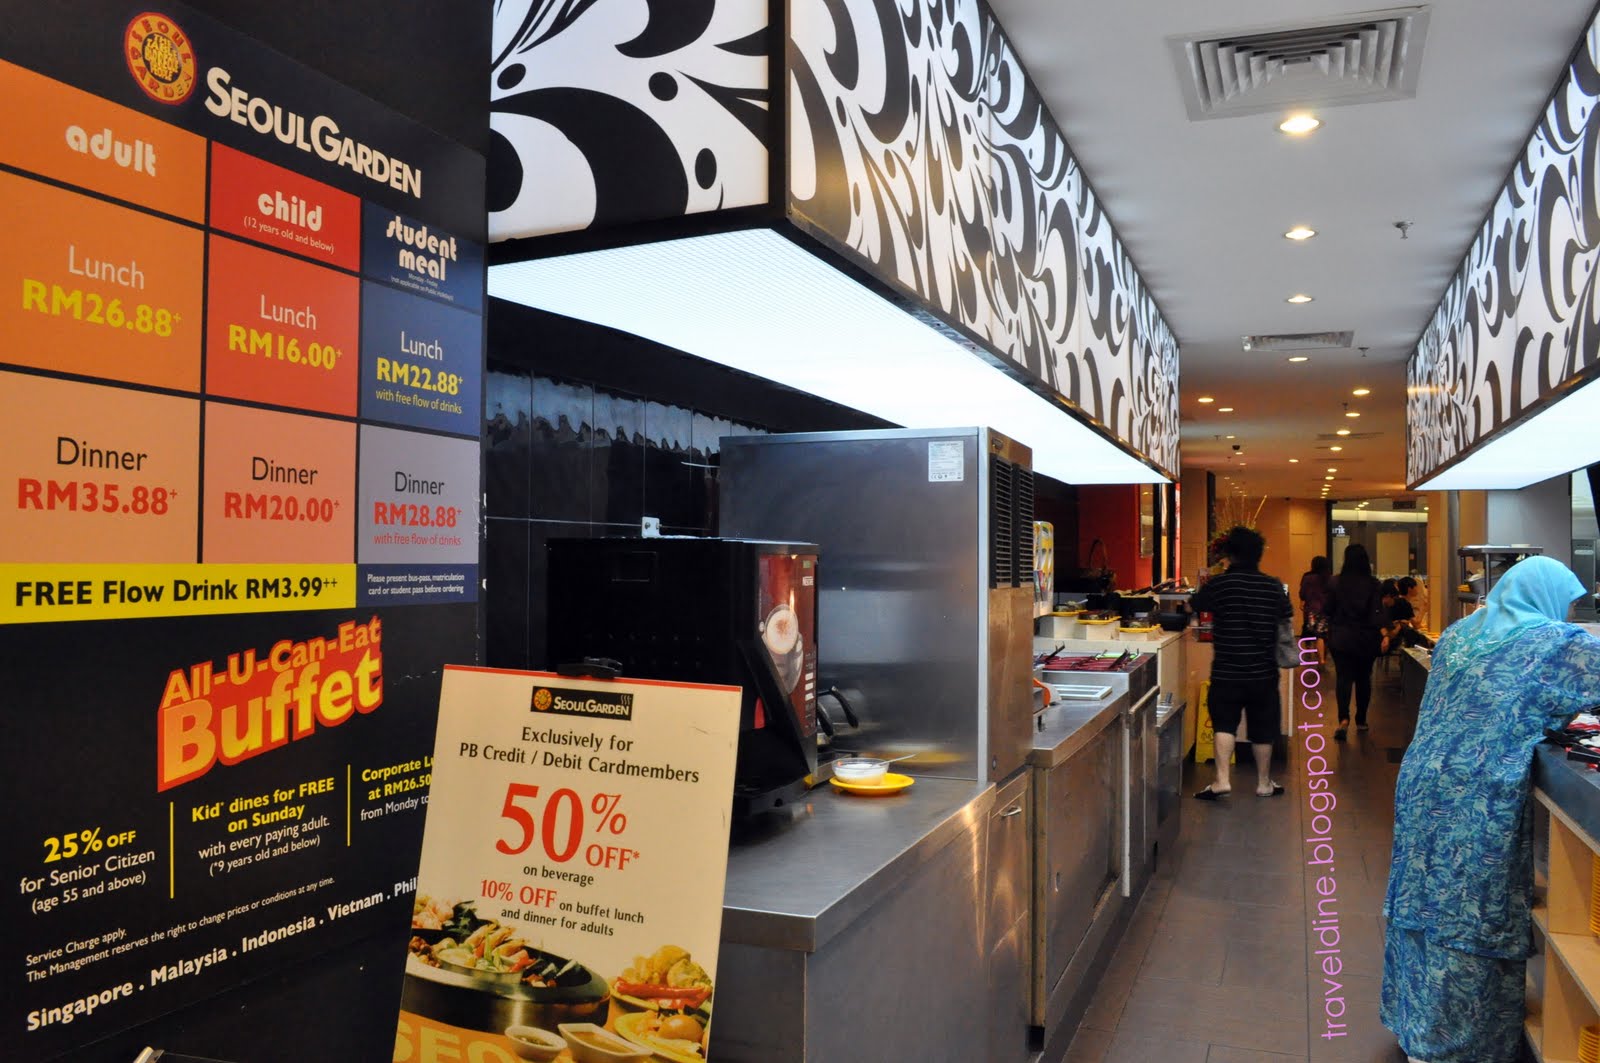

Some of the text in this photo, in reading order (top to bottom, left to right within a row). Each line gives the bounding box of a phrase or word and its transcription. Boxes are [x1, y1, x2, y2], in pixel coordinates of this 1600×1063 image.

[65, 125, 156, 177] adult
[257, 190, 322, 232] child
[243, 215, 335, 254] (12 years old and below)
[386, 215, 457, 262] student
[68, 244, 145, 290] Lunch
[399, 248, 446, 281] meal
[22, 278, 182, 337] RM26.88+
[260, 294, 317, 330] Lunch
[401, 331, 443, 361] Lunch
[376, 357, 463, 396] RM22.88+
[375, 388, 462, 415] with free flow of drinks
[56, 436, 148, 471] Dinner
[252, 456, 318, 485] Dinner
[17, 478, 178, 515] RM35.88+
[394, 471, 445, 496] Dinner
[224, 492, 340, 523] RM20.00+
[374, 501, 462, 528] RM28.88+
[374, 532, 461, 546] with free flow of drinks
[15, 577, 338, 607] FREE Flow Drink RM3.99++
[367, 573, 386, 583] Please
[386, 575, 407, 585] present
[432, 572, 465, 582] matriculation
[368, 584, 464, 596] card or student pass before ordering
[162, 615, 382, 709] All-U-Can-Eat
[162, 648, 382, 784] Buffet
[521, 725, 634, 752] Exclusively for
[361, 759, 422, 782] Corporate
[459, 742, 478, 758] PB
[483, 744, 526, 764] Credit
[543, 750, 583, 771] Debit
[588, 756, 700, 783] Cardmembers
[229, 794, 270, 814] dines
[273, 788, 296, 804] for
[299, 777, 335, 798] FREE
[360, 807, 383, 822] from
[385, 796, 419, 815] Monday
[368, 787, 382, 801] at
[227, 804, 305, 833] on Sunday
[43, 827, 137, 864] 25% OFF
[198, 815, 330, 860] with every paying adult.
[227, 854, 253, 873] years
[255, 848, 271, 862] old
[272, 843, 289, 858] and
[290, 834, 321, 852] below)
[20, 850, 156, 895] for Senior Citizen
[523, 864, 595, 888] on beverage
[32, 870, 147, 915] (age 55 and above)
[480, 879, 645, 924] 10% OFF on buffet lunch
[26, 876, 335, 983] The Management reserves the right to change prices or conditions at any time.
[501, 907, 614, 937] and dinner for adults
[26, 926, 127, 967] Service Charge apply.
[26, 981, 134, 1032] Singapore
[150, 946, 228, 988] Malaysia
[242, 915, 316, 953] Indonesia
[327, 891, 384, 922] Vietnam
